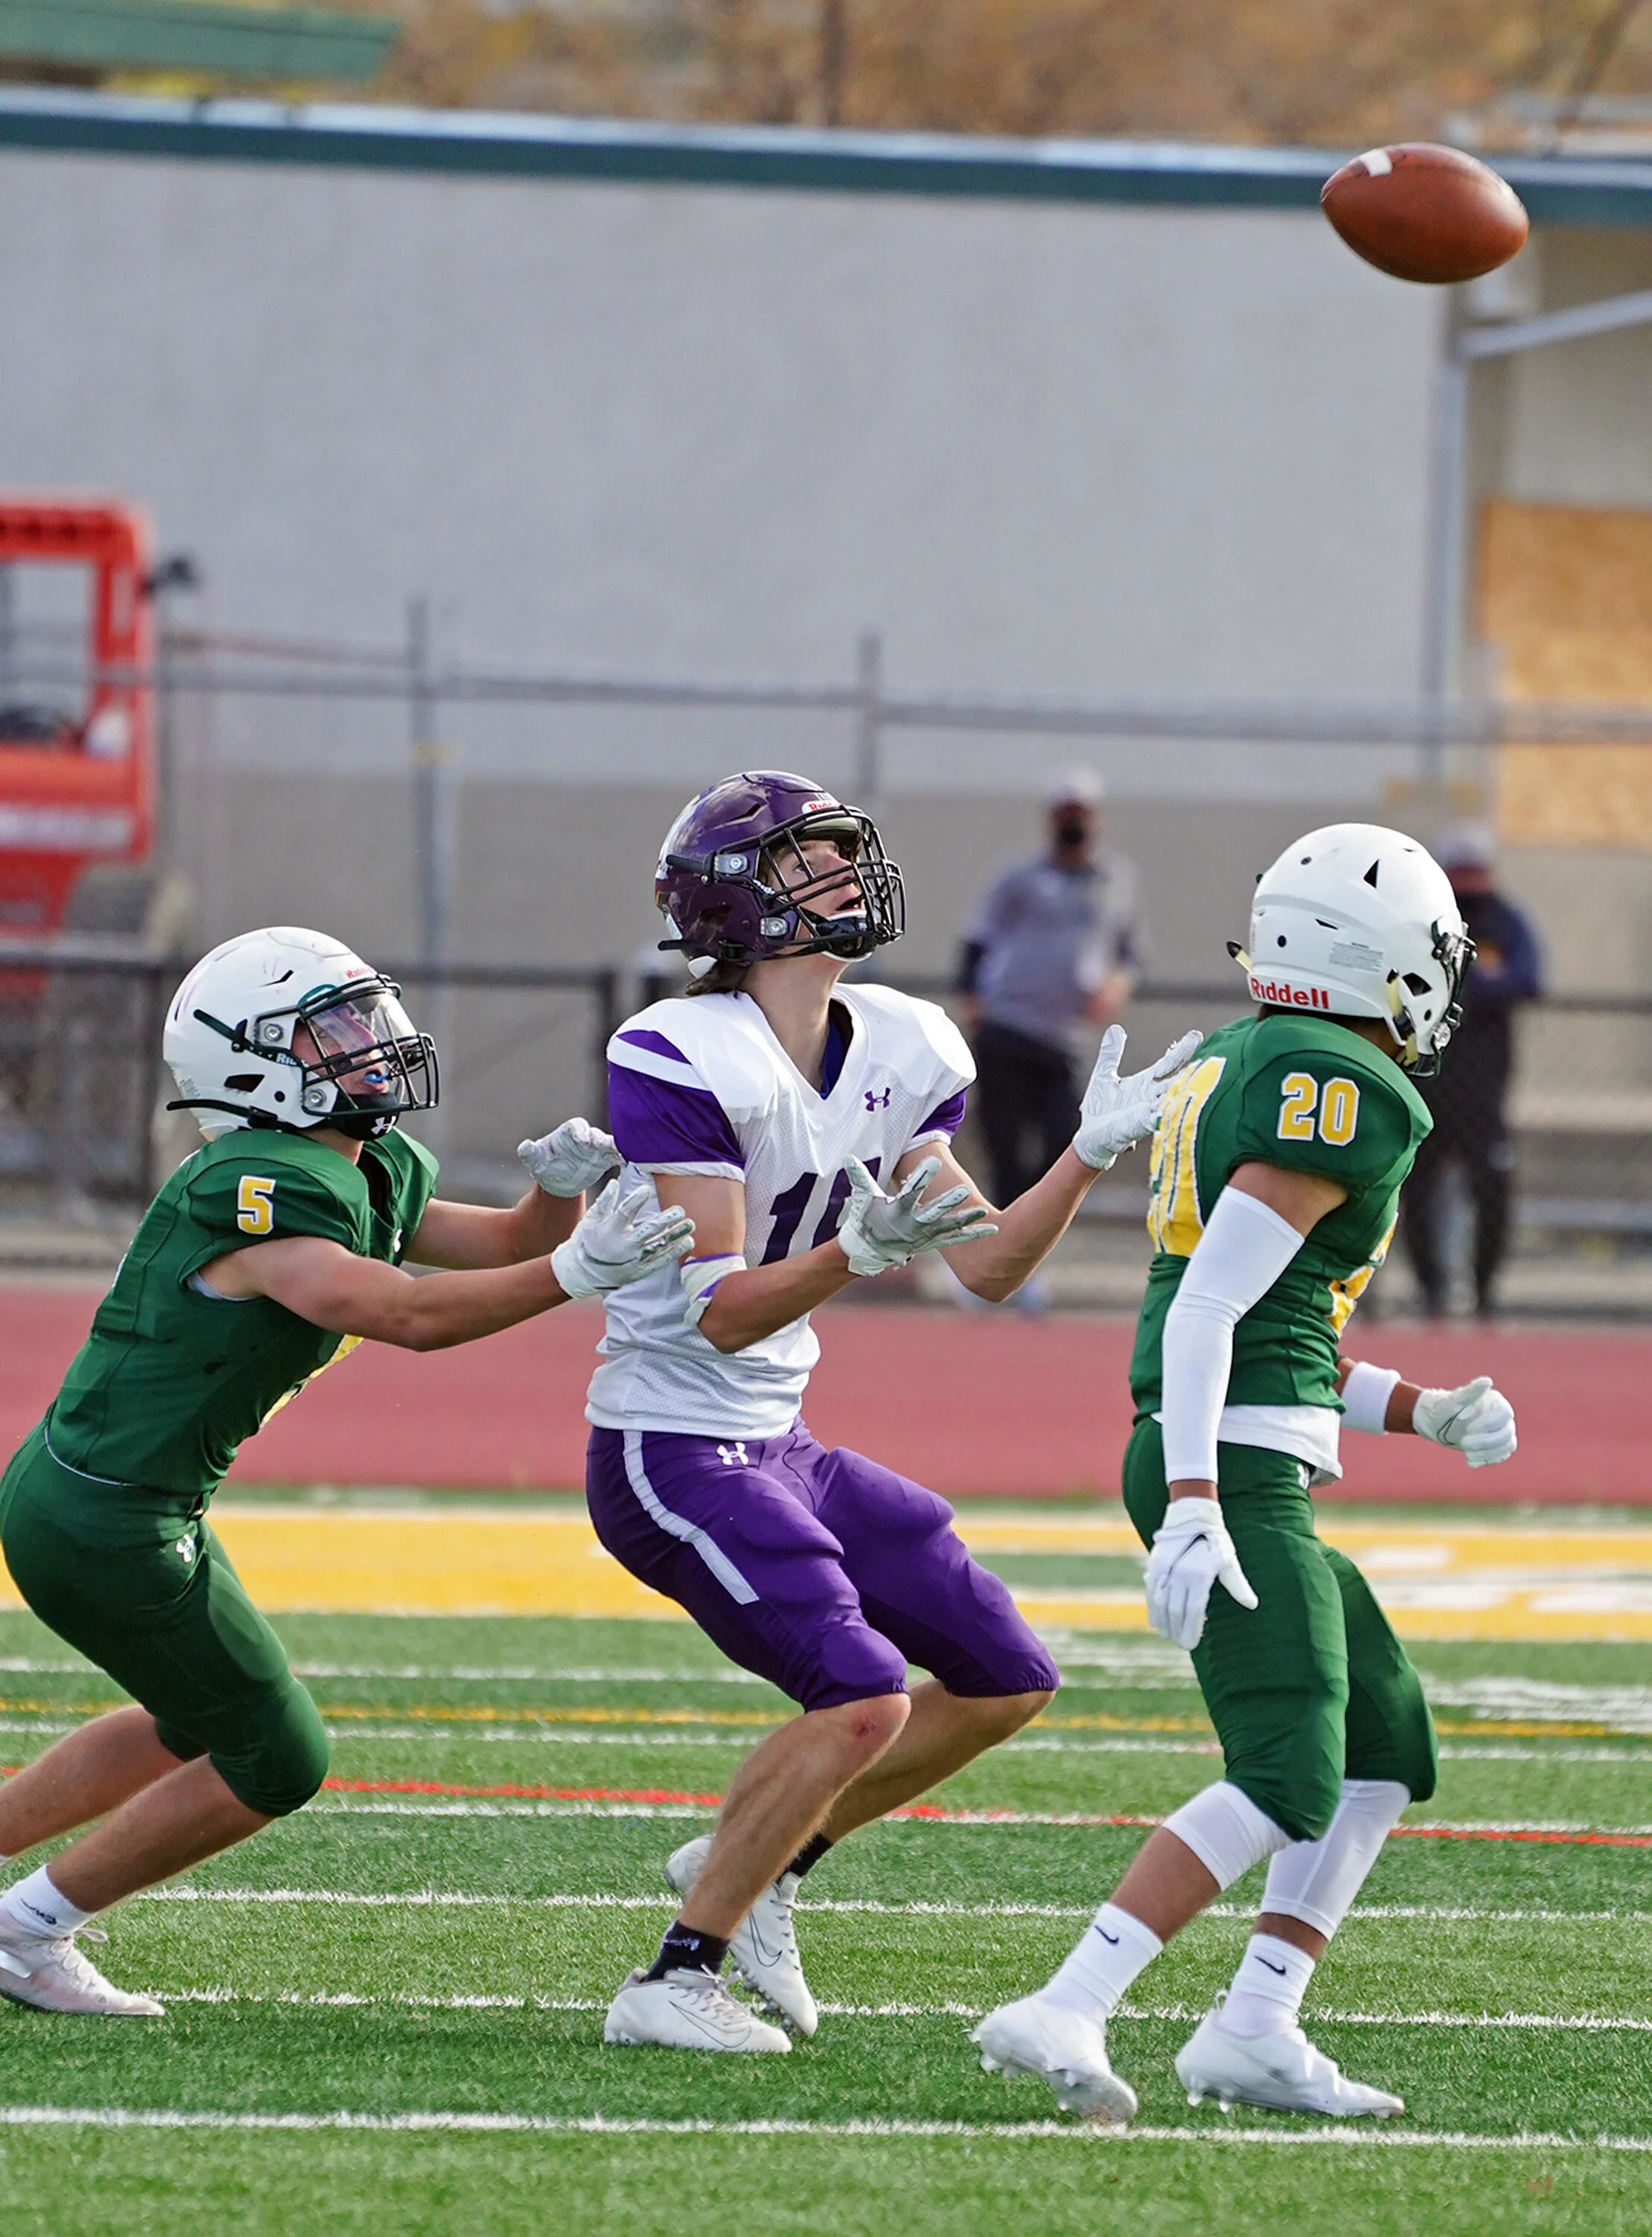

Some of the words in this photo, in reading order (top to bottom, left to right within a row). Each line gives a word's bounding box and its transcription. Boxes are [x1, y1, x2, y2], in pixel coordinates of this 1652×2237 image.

[1250, 977, 1329, 1010] Riddell
[1276, 1072, 1361, 1147] 20
[237, 1175, 276, 1235] 5
